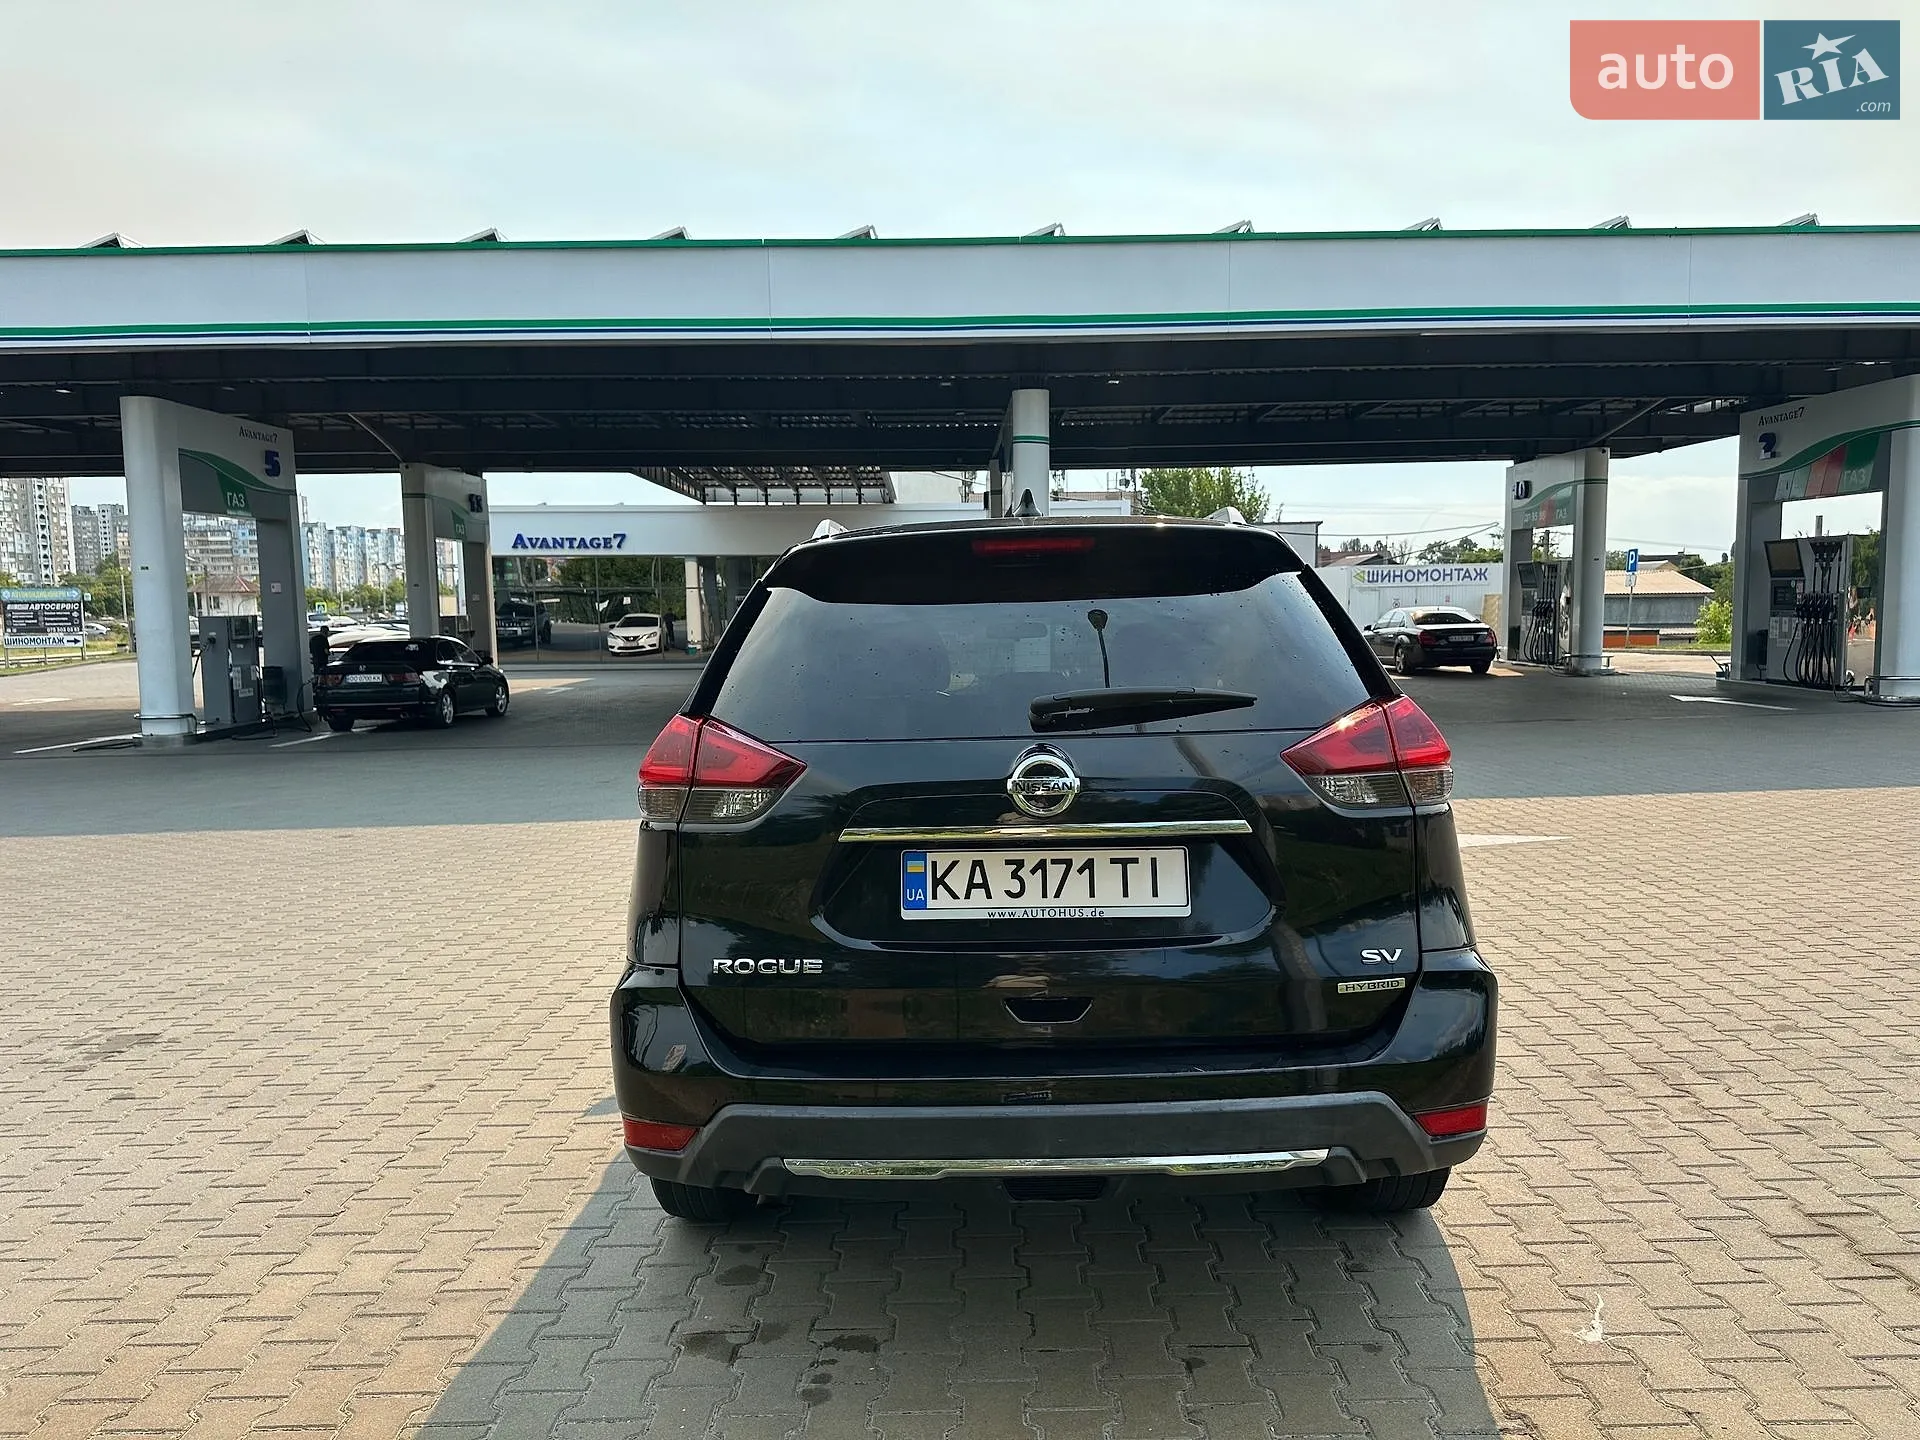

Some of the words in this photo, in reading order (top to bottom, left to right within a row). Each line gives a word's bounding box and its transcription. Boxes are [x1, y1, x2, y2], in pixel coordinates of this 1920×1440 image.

[265, 450, 281, 477] 5
[227, 491, 245, 508] ГАЗ
[512, 533, 626, 549] AVANTAGE7
[1629, 551, 1635, 570] P
[1367, 567, 1488, 583] ШИНОМОНТАЖ
[5, 637, 65, 645] ШИНОМОНТАЖ
[1015, 782, 1073, 792] NISSAN
[931, 860, 993, 900] KA
[1003, 858, 1096, 899] 3171
[1109, 857, 1159, 898] TI
[906, 889, 925, 901] UA
[987, 908, 1105, 918] www.AUTOHUS.de
[1361, 949, 1402, 965] SV
[713, 958, 823, 974] ROGUE
[1345, 980, 1400, 992] HYBRID
